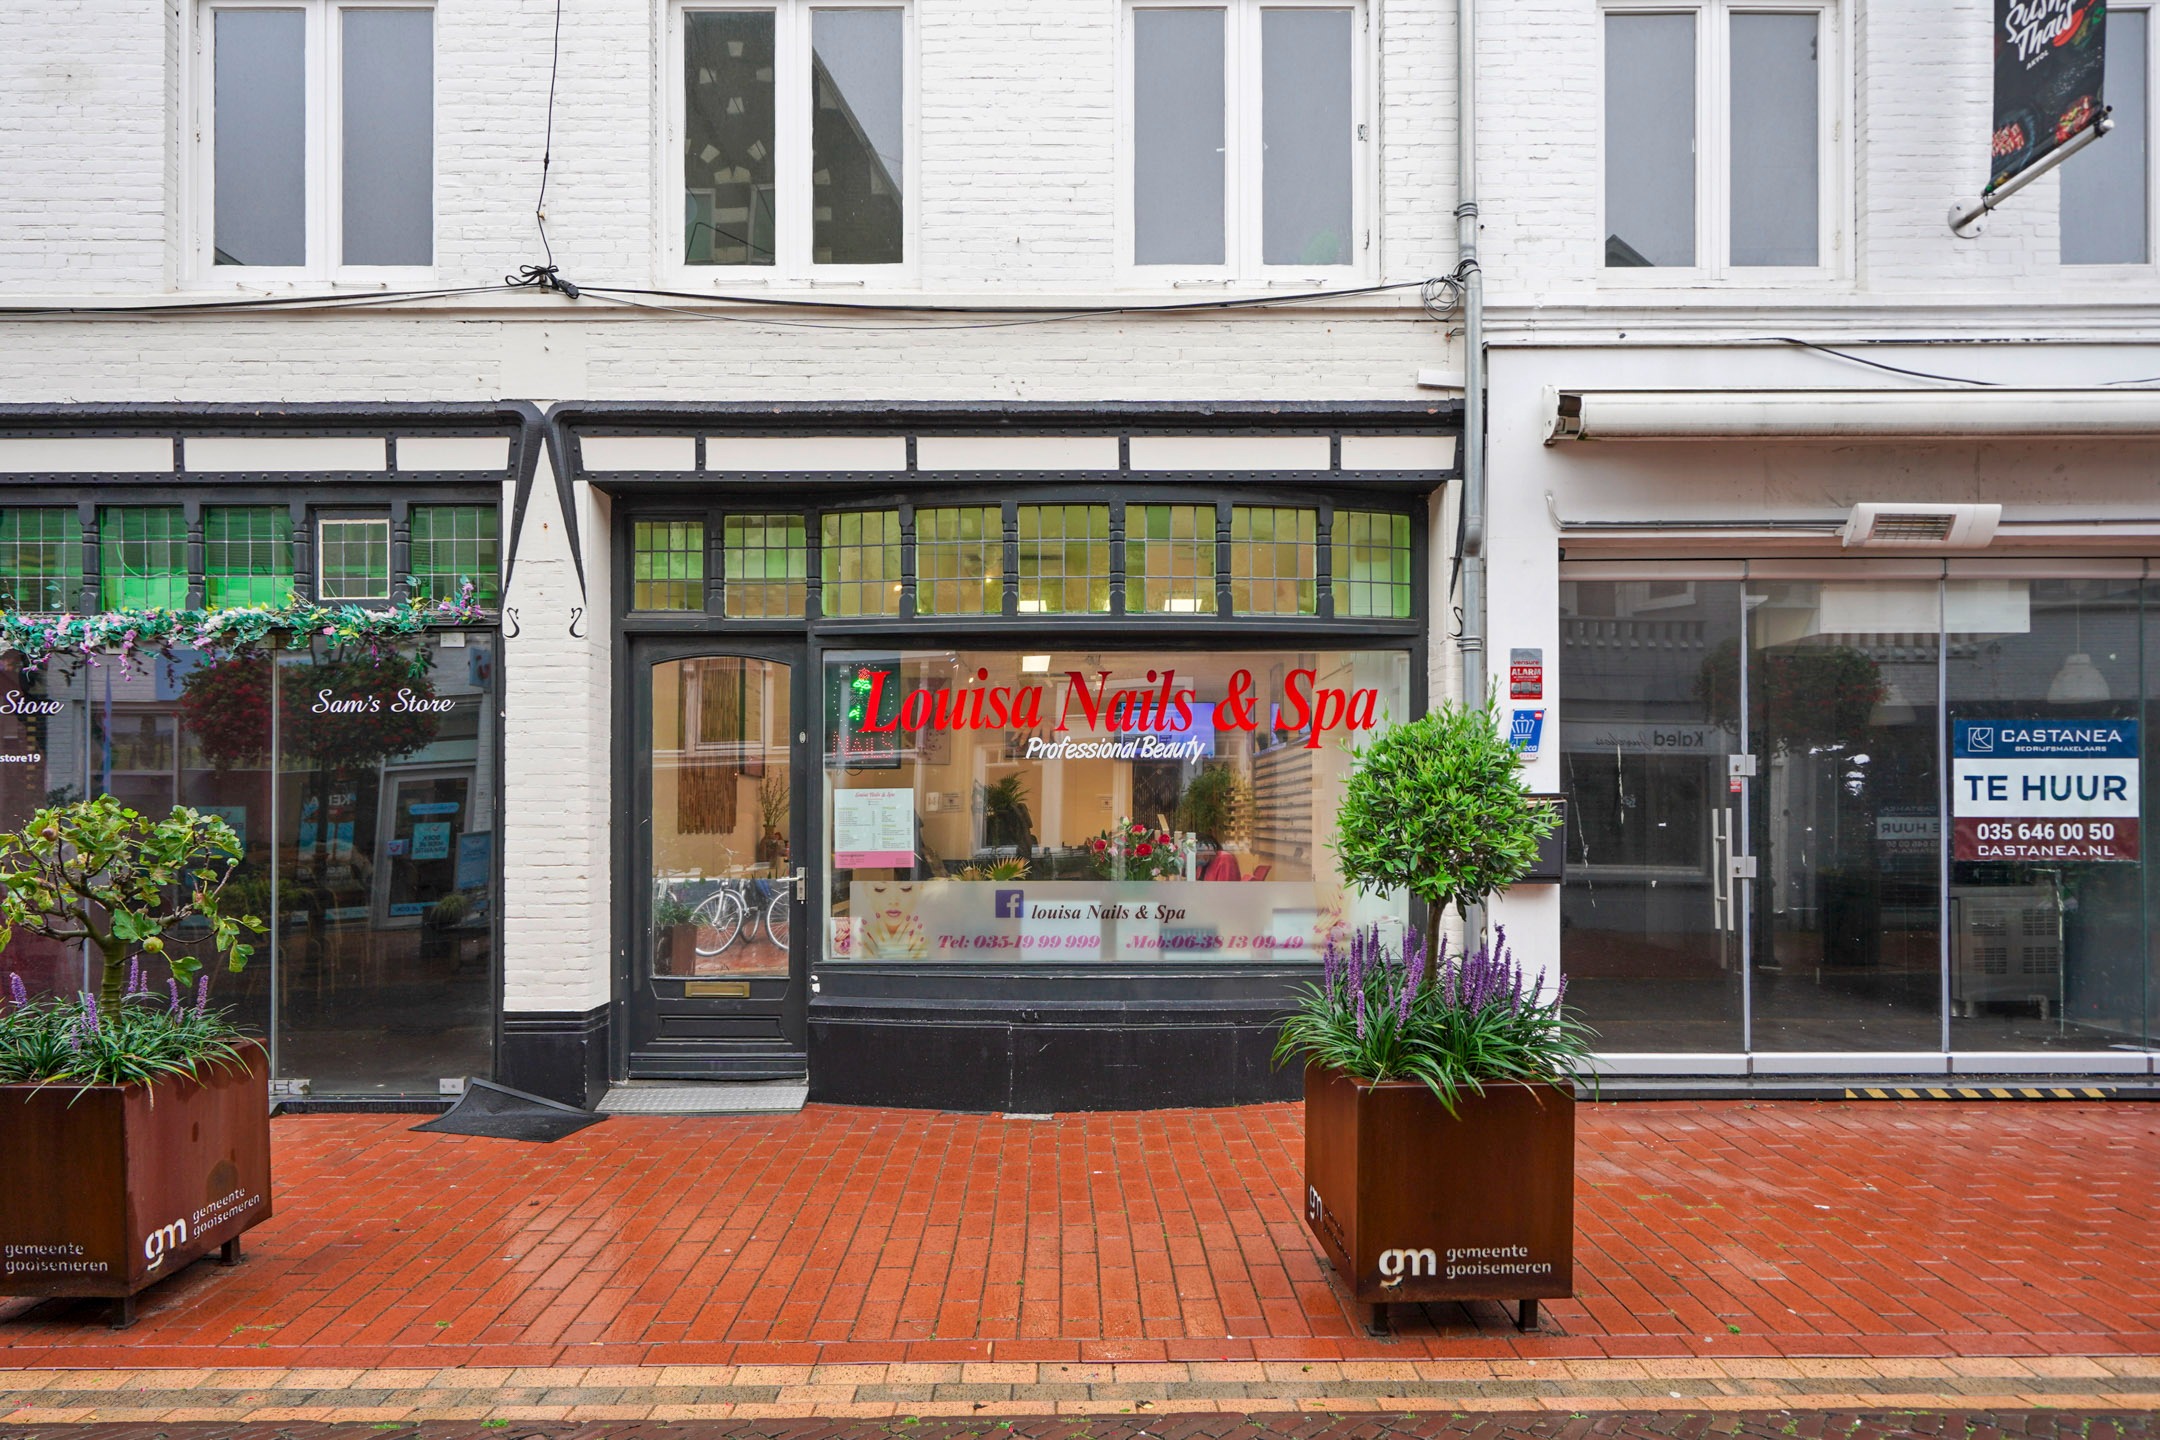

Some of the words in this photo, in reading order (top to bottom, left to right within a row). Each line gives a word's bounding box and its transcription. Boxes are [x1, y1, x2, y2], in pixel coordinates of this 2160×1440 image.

[1511, 668, 1542, 676] ALARM
[0, 689, 64, 714] Store
[311, 688, 381, 713] Sam's
[390, 687, 456, 713] Store
[857, 667, 1044, 733] Louisa
[1054, 669, 1196, 732] Nails
[1211, 668, 1260, 732] &
[1274, 668, 1378, 749] Spa
[832, 731, 894, 759] NAILS
[2001, 729, 2122, 743] CASTANEA
[1025, 735, 1140, 762] Professional
[1141, 734, 1206, 767] Beauty
[1963, 774, 2008, 801] TE
[2022, 774, 2128, 801] HUUR
[1976, 823, 2013, 841] 035
[2017, 823, 2056, 841] 646
[2059, 823, 2084, 841] 00
[2088, 823, 2115, 841] 50
[1977, 845, 2115, 857] CASTANEA.NL
[1031, 904, 1081, 920] louisa
[1086, 904, 1130, 920] Nails
[1134, 904, 1149, 920] &
[1154, 904, 1186, 923] Spa
[937, 934, 969, 949] Tel:
[1037, 935, 1062, 949] 99
[1065, 935, 1101, 949] 999
[1226, 935, 1249, 949] 13
[192, 1187, 246, 1225] gemeente
[193, 1193, 261, 1240] gooisemeren
[5, 1242, 84, 1258] gemeente
[144, 1218, 187, 1271] gm
[1446, 1244, 1529, 1263] gemeente
[5, 1257, 109, 1275] gooisemeren
[1378, 1248, 1438, 1290] gm
[1445, 1260, 1552, 1280] gooisemeren
